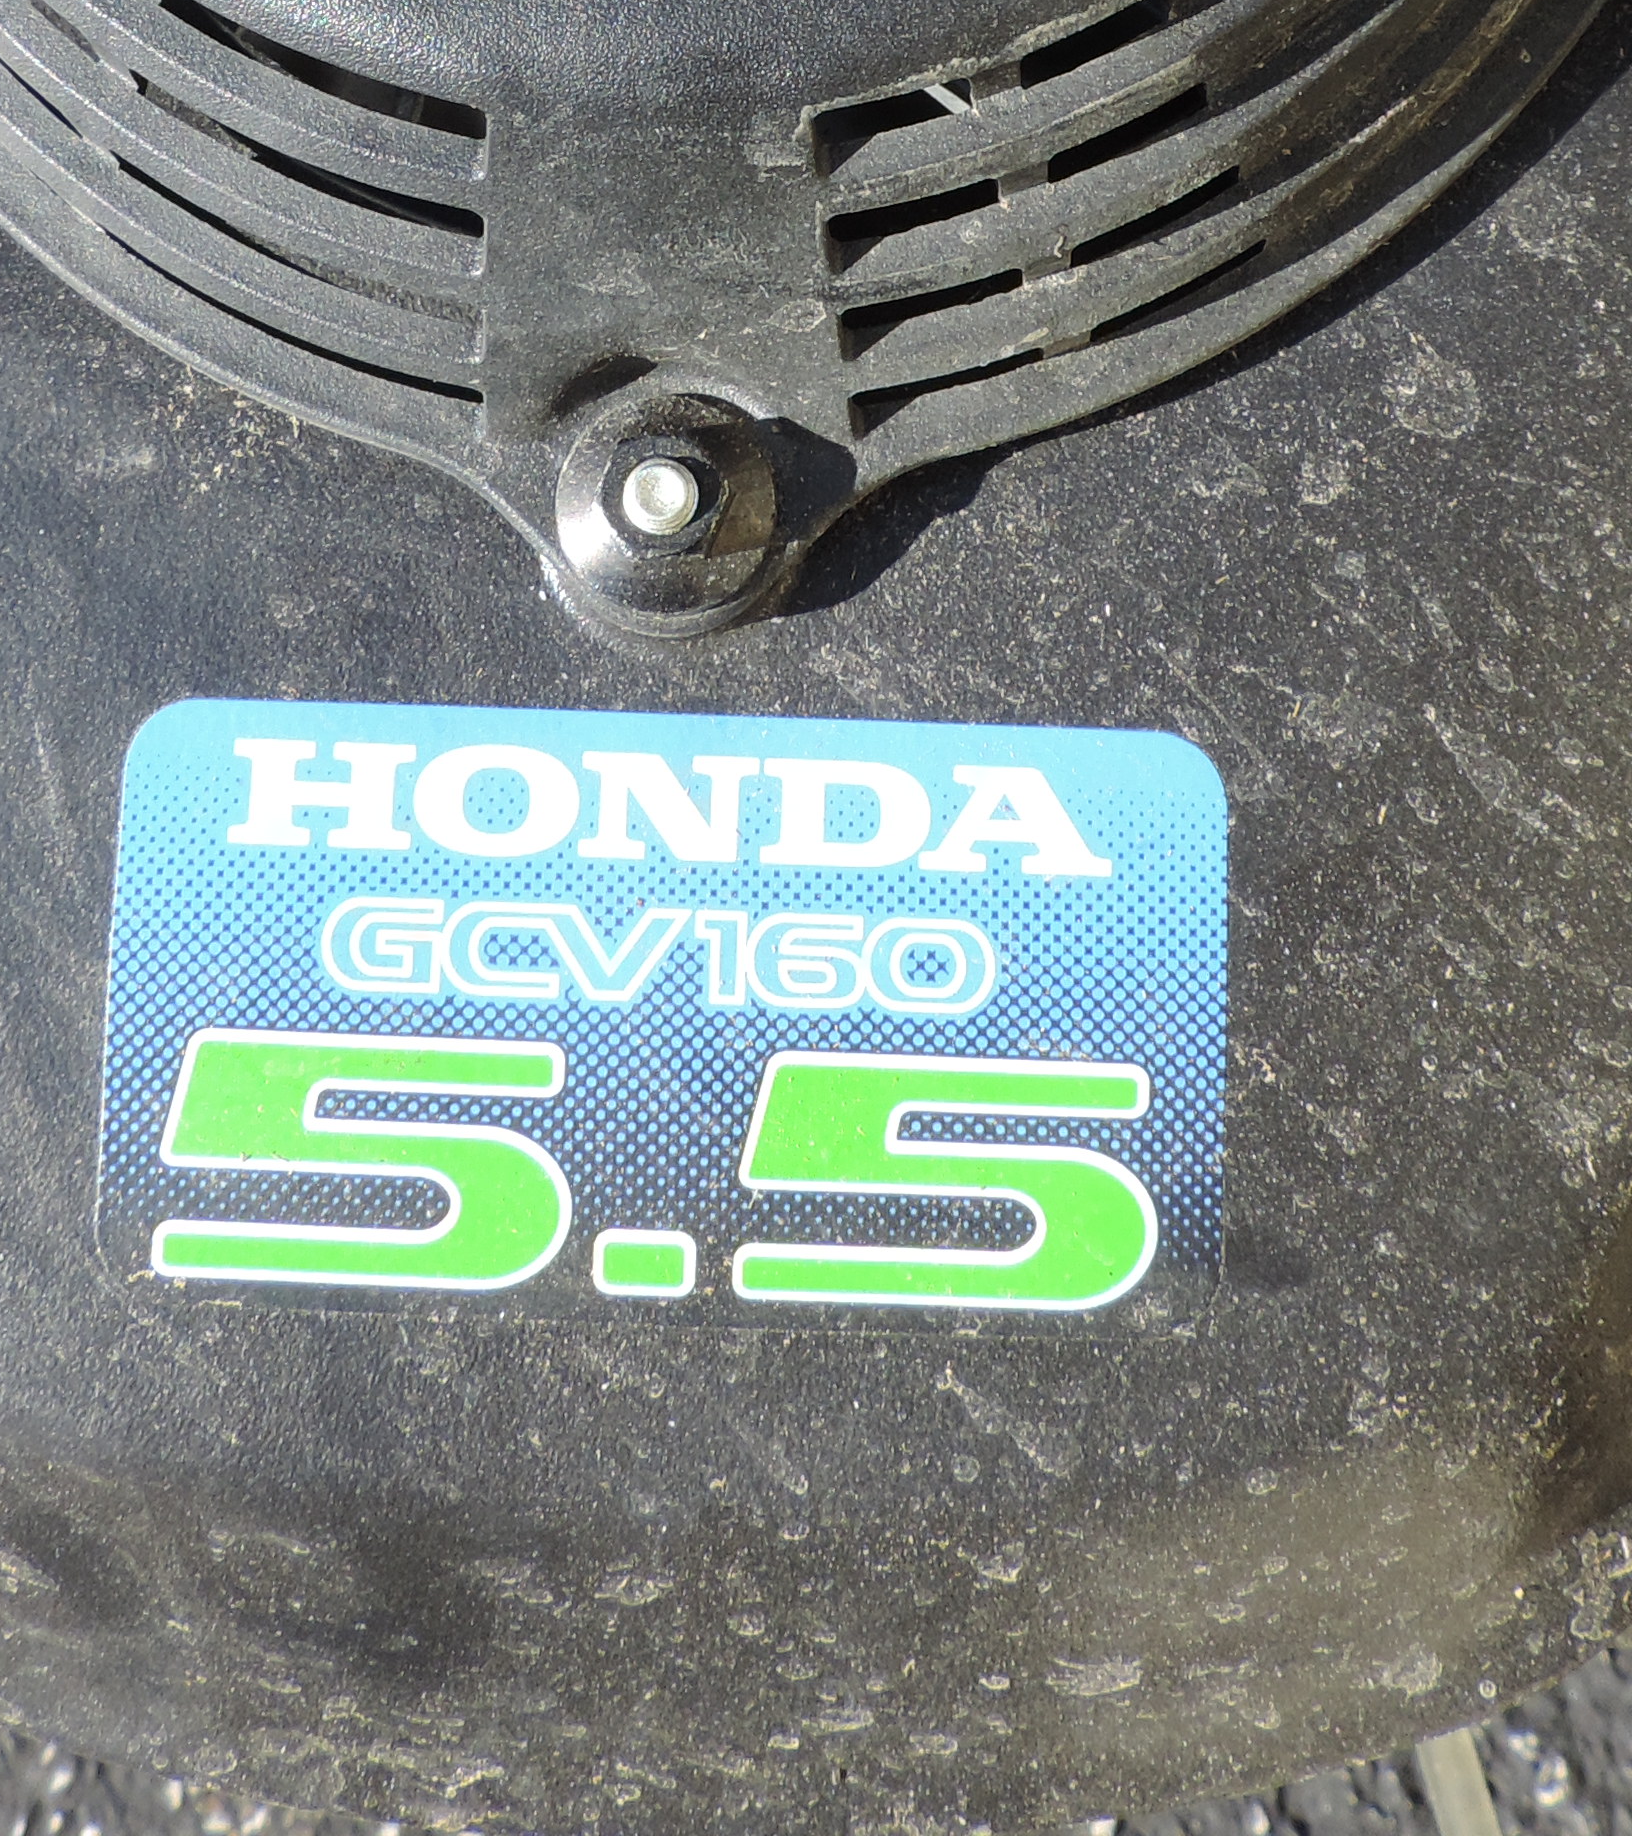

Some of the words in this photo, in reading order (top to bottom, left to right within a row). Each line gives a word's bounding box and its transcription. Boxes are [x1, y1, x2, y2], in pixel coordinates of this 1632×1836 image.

[226, 737, 1113, 878] HONDA
[321, 895, 997, 1014] GCV160
[150, 1027, 1158, 1311] 5.5
